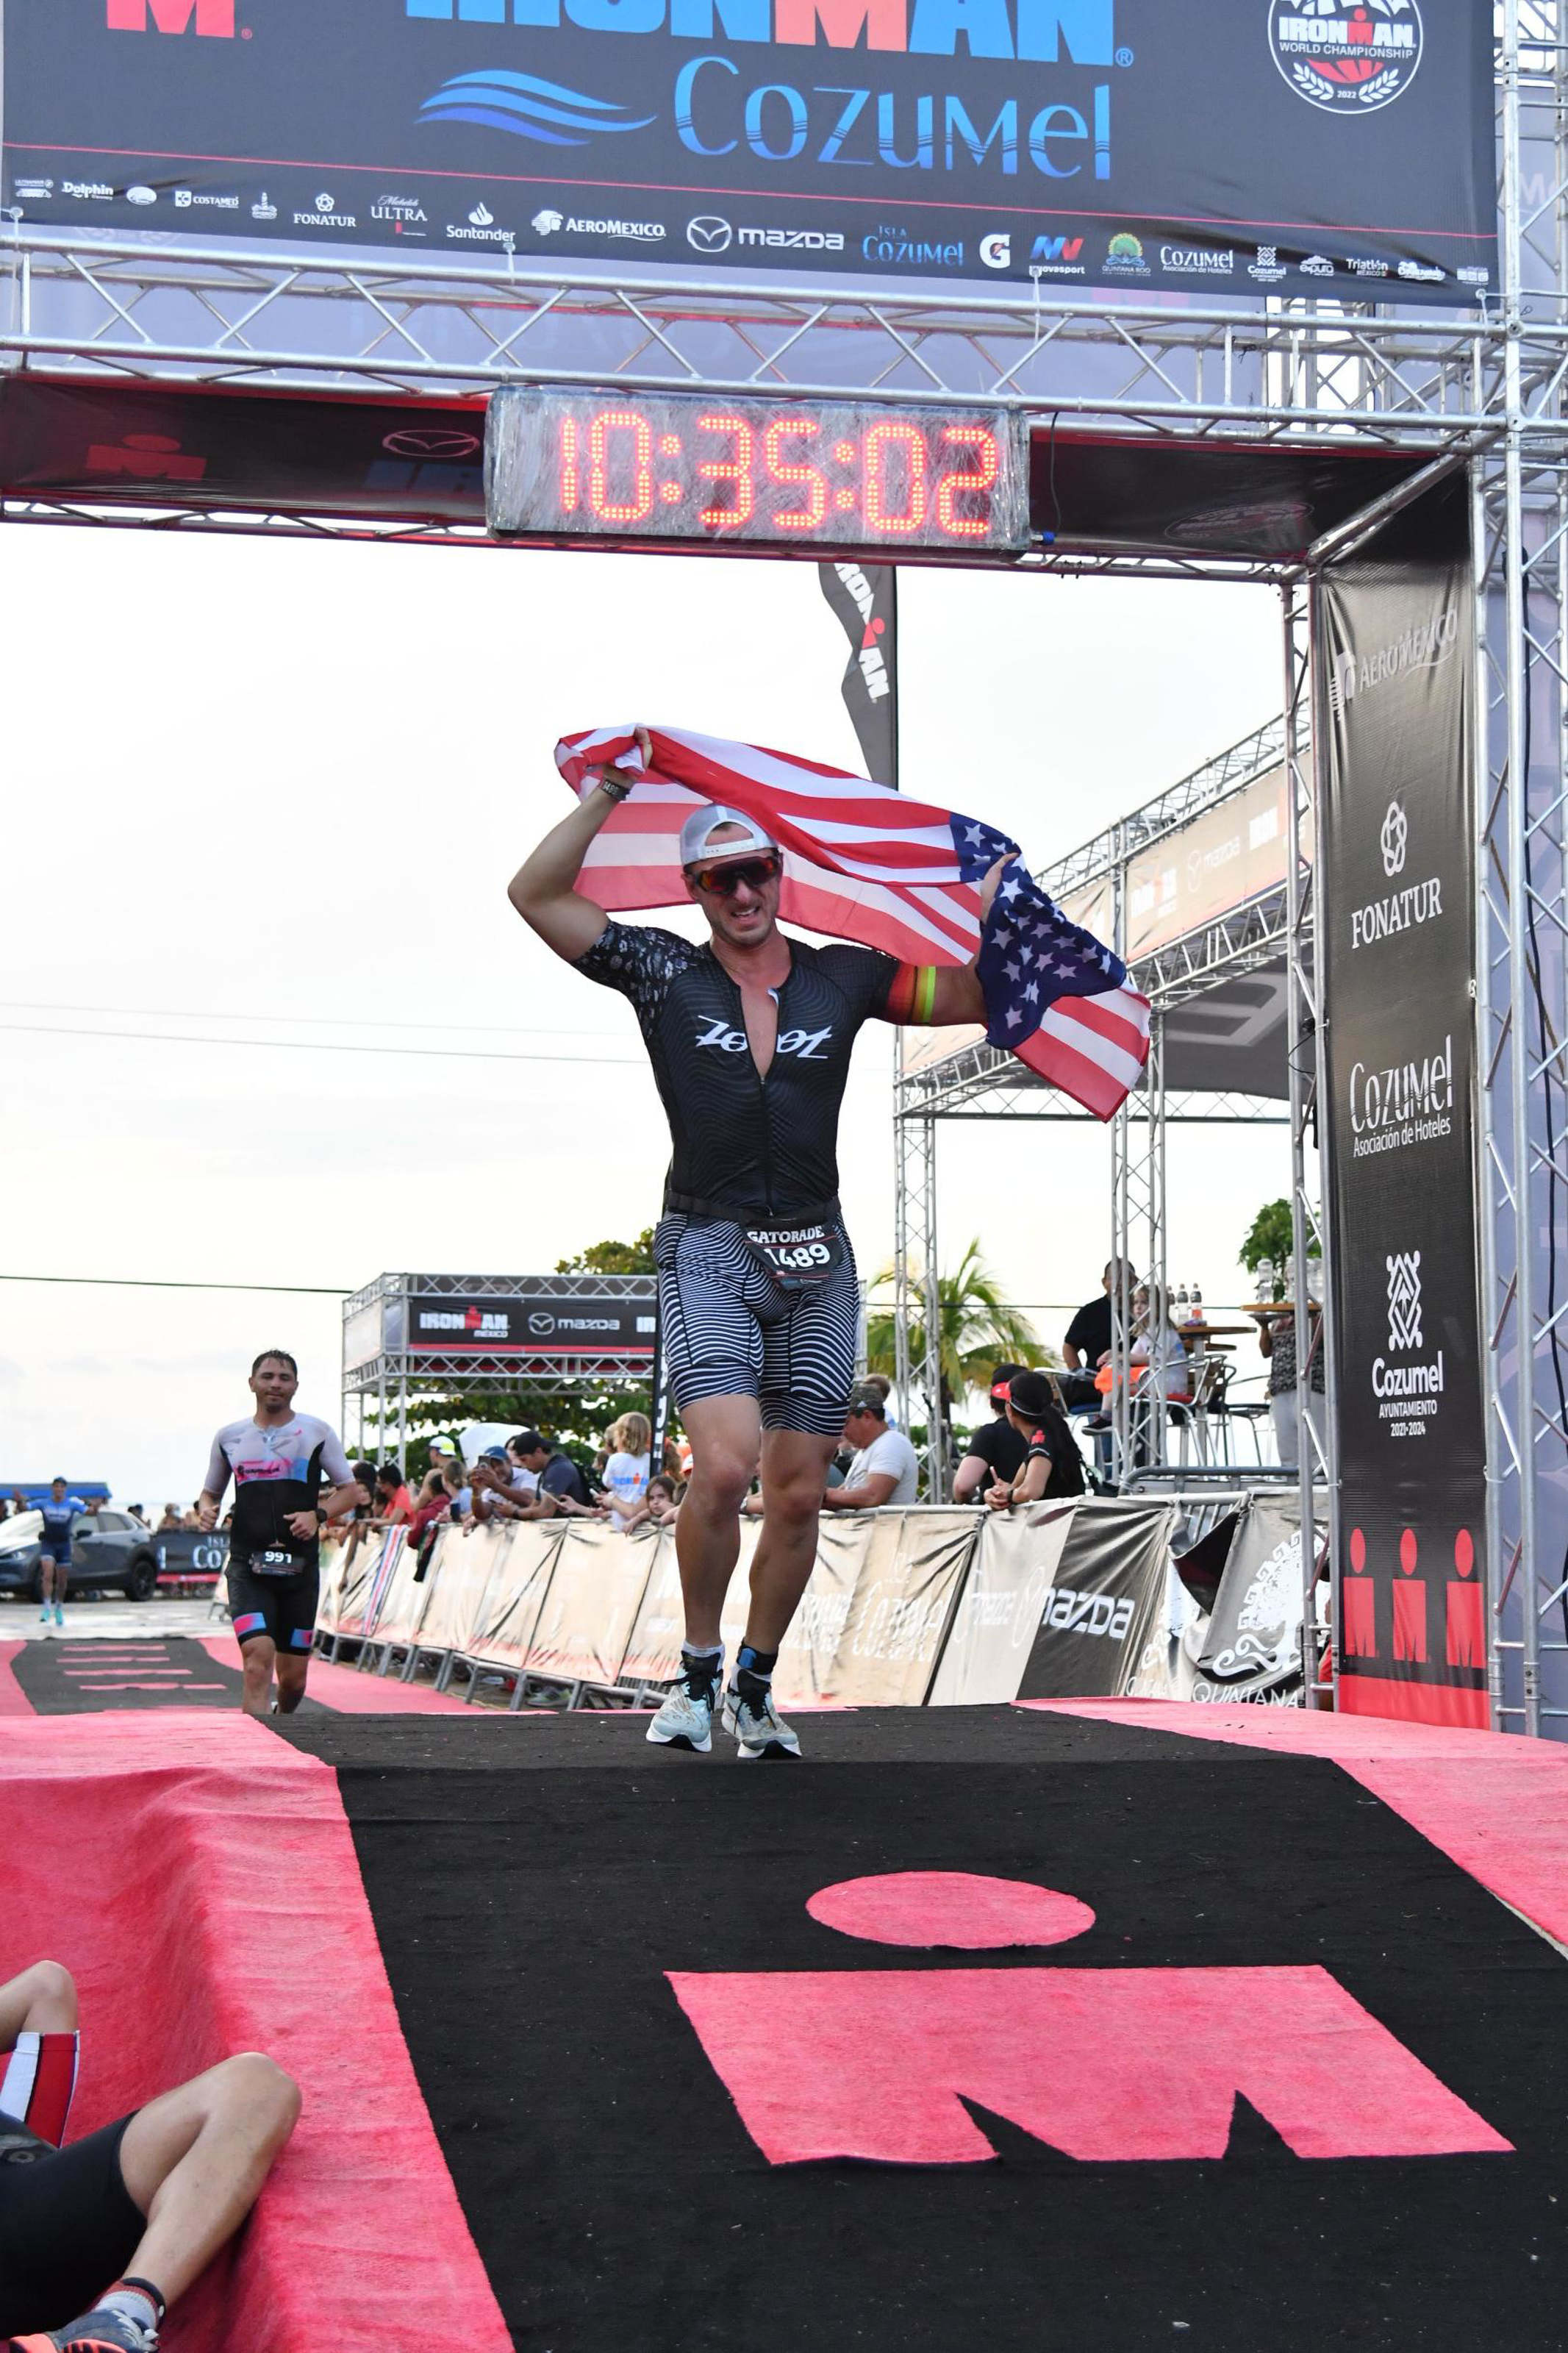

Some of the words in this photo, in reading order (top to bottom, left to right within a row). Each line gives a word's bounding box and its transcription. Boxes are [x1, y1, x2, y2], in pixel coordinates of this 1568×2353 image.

[1278, 10, 1414, 48] IRONMAN
[1280, 42, 1320, 54] WORLD
[1323, 45, 1413, 59] CHAMPIONSHIP
[1337, 90, 1357, 99] 2022
[62, 182, 113, 198] Dolphin
[193, 196, 239, 206] COSTAMED
[293, 213, 357, 227] FONATUR
[370, 206, 428, 221] ULTRA
[446, 225, 515, 241] Santander
[1247, 265, 1286, 275] Cozumel
[561, 411, 998, 535] 10:35:02
[1351, 877, 1442, 949] FONATUR
[1353, 1126, 1400, 1158] Asociación
[1401, 1122, 1414, 1146] de
[1415, 1113, 1450, 1141] Hoteles
[747, 1226, 825, 1243] GATORADE
[764, 1243, 830, 1268] 1489
[420, 1308, 509, 1329] IRONMAN
[1372, 1350, 1444, 1397] Cozumel
[1379, 1399, 1437, 1418] AYUNTAMIENTO
[265, 1551, 292, 1563] 991
